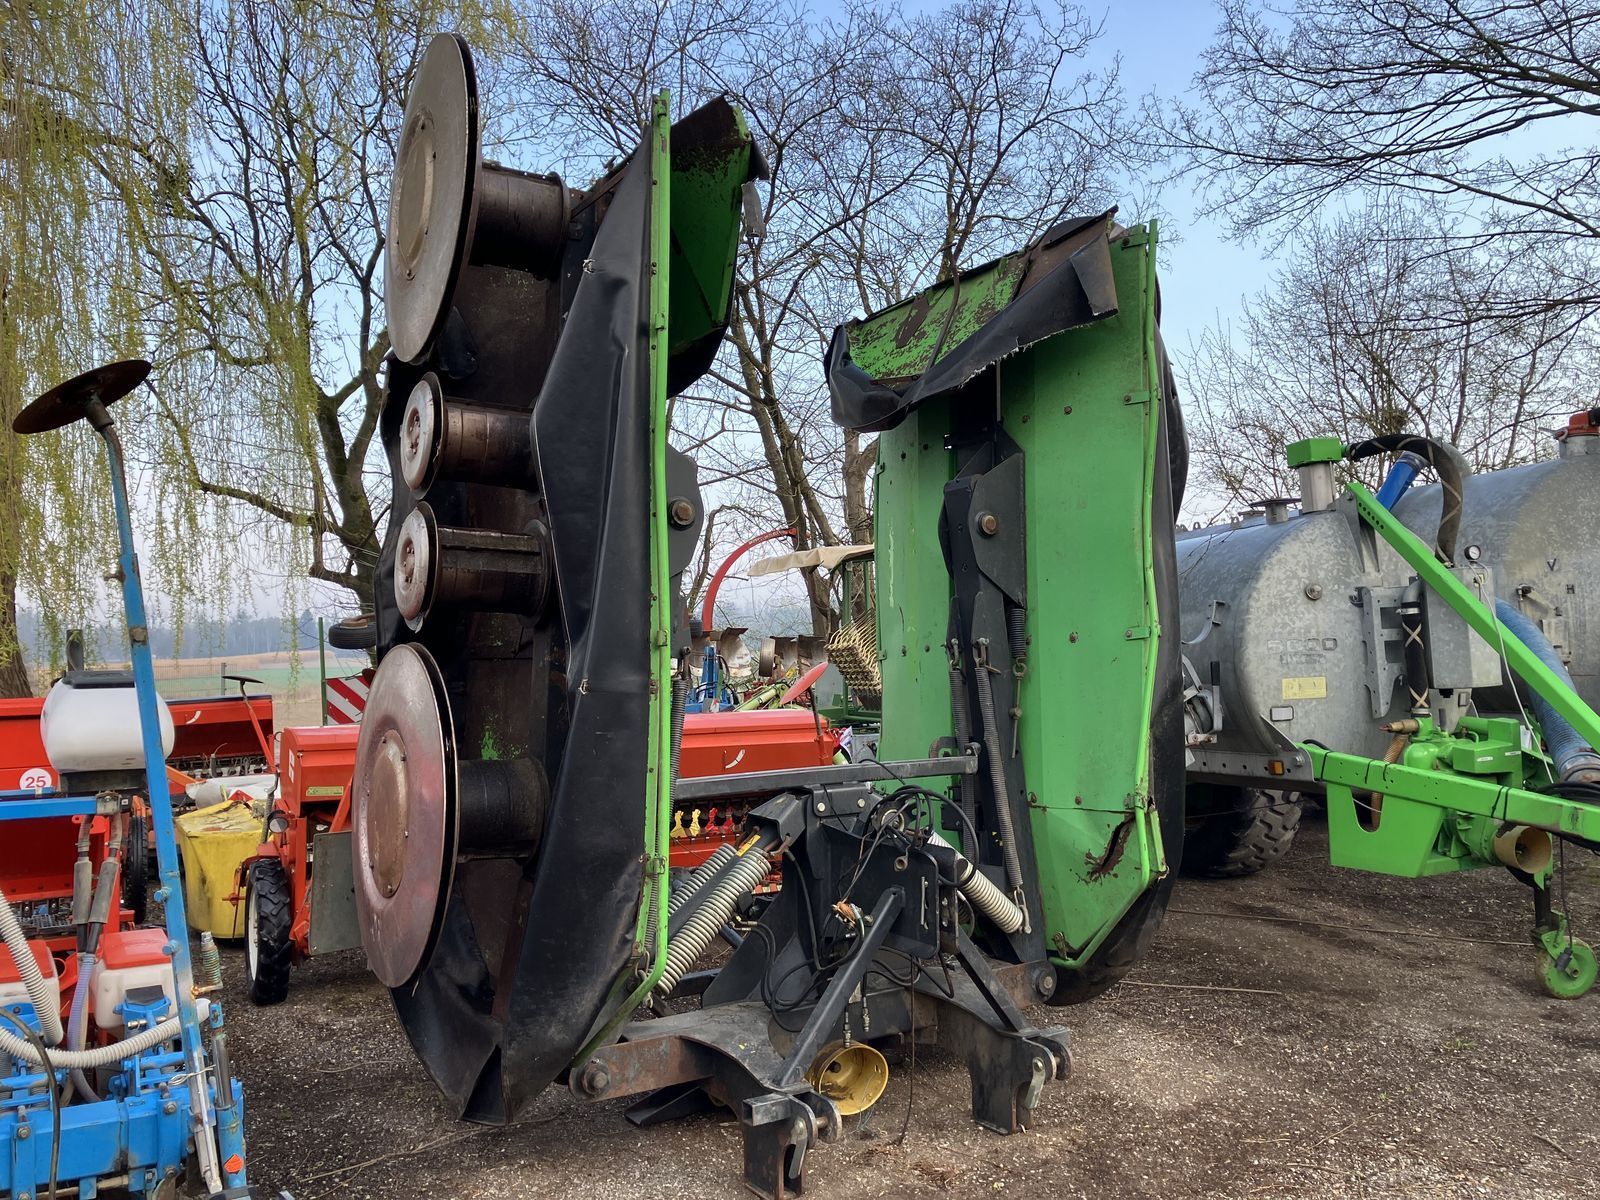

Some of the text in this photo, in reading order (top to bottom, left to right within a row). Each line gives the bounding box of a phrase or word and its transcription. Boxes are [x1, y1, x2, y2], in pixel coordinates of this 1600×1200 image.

[1547, 558, 1557, 571] V
[1566, 584, 1575, 594] H
[25, 776, 47, 788] 25
